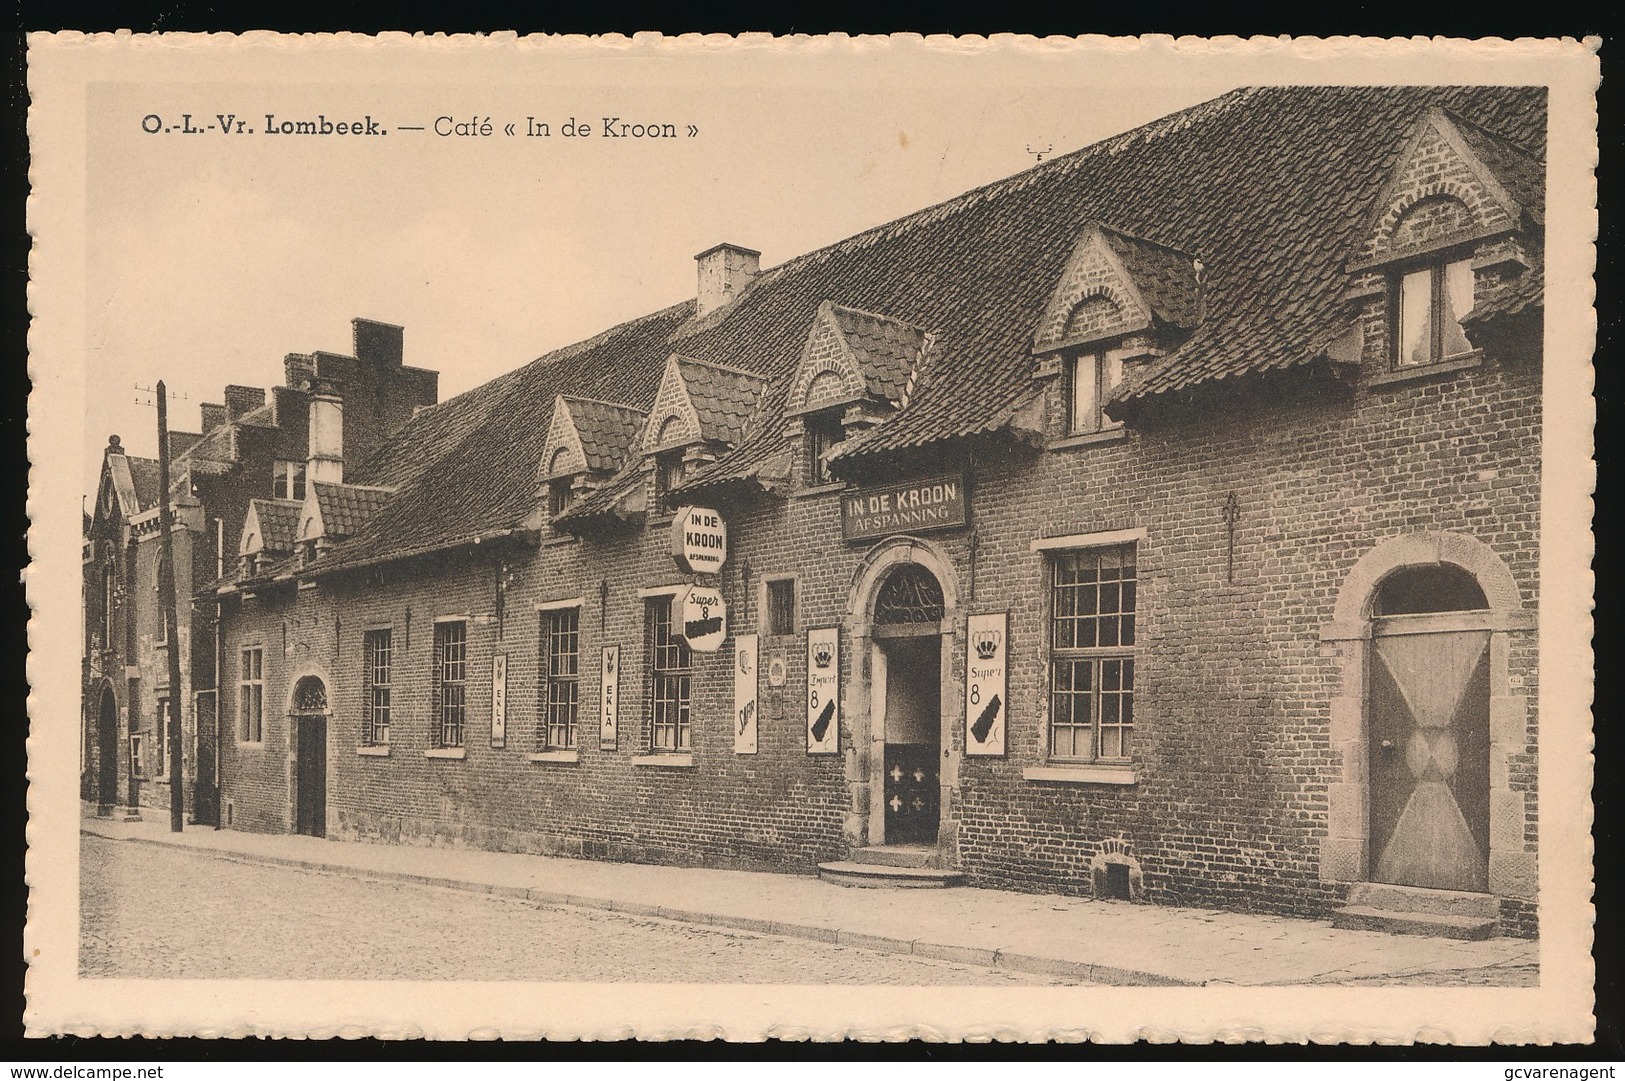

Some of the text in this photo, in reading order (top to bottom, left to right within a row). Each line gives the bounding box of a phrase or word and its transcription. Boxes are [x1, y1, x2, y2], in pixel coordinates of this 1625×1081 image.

[849, 483, 956, 516] IN DE KROON
[691, 514, 718, 528] IN DE
[854, 505, 949, 532] AFSPANNING
[686, 532, 722, 549] KROON
[689, 553, 719, 563] AFSPANNING
[690, 593, 718, 608] Super
[702, 606, 709, 619] 8
[971, 667, 1001, 680] Super
[810, 690, 819, 709] 8
[970, 684, 980, 705] 8
[605, 685, 613, 727] EKLA
